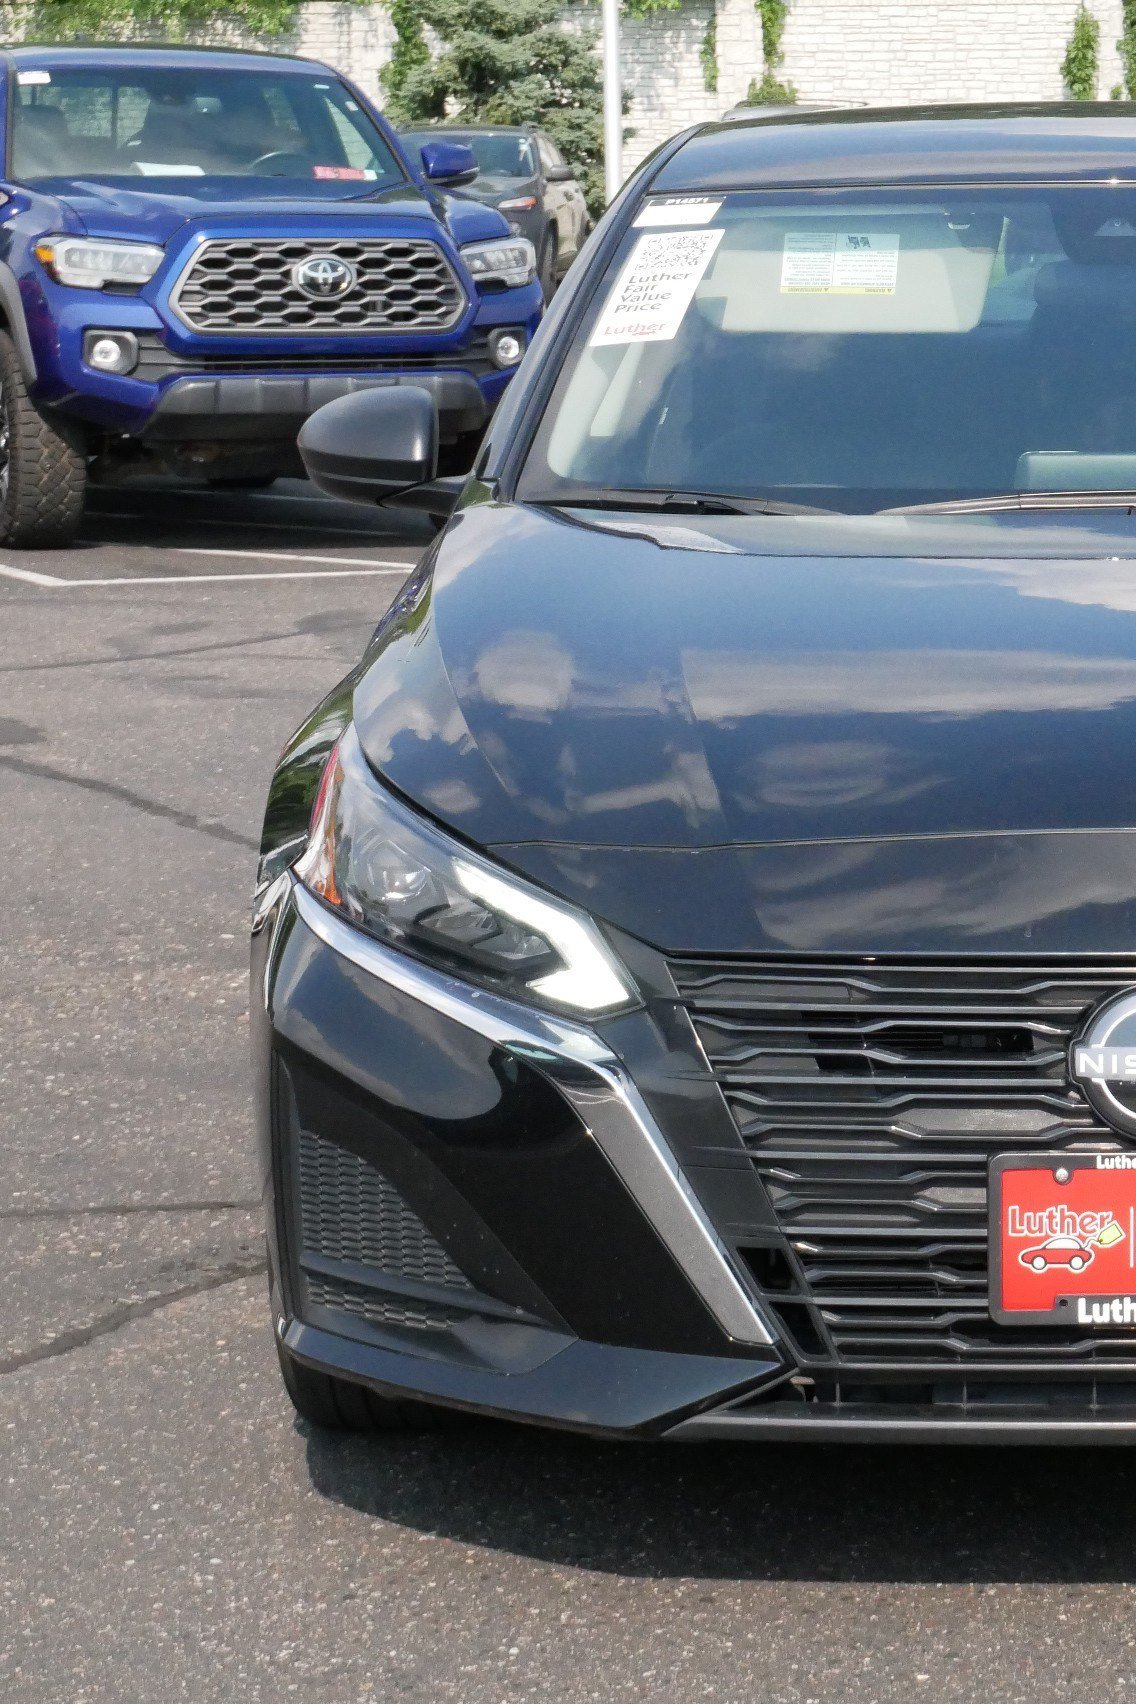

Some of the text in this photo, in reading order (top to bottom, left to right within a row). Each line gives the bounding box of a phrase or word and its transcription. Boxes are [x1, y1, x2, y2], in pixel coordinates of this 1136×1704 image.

[629, 273, 692, 284] Luther
[624, 284, 658, 293] Fair
[621, 293, 672, 302] Value
[614, 303, 661, 313] Price
[604, 323, 666, 336] Luther
[1008, 1205, 1113, 1237] Luther
